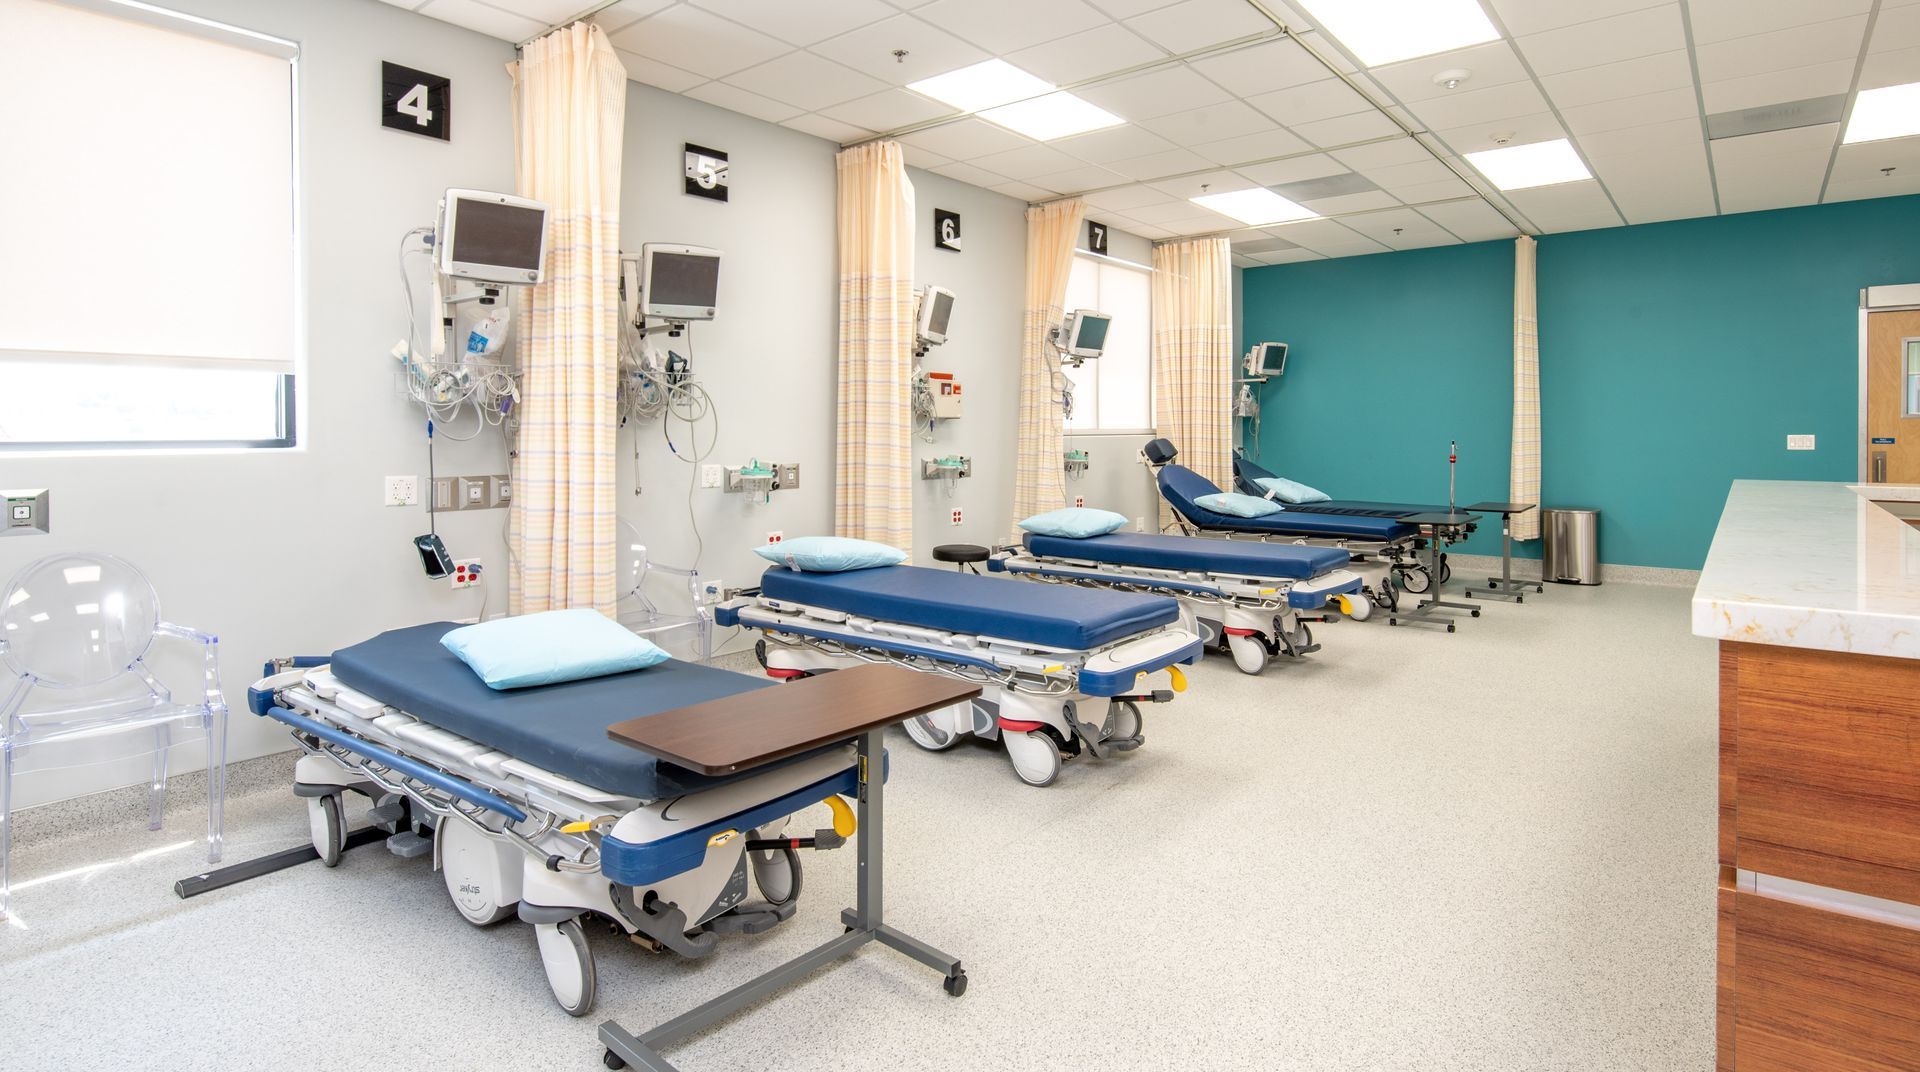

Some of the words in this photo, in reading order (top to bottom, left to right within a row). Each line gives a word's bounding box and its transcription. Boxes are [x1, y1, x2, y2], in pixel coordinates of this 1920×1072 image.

[397, 83, 432, 127] 4
[697, 154, 717, 190] 5
[942, 218, 955, 243] 6
[1094, 227, 1104, 249] 7
